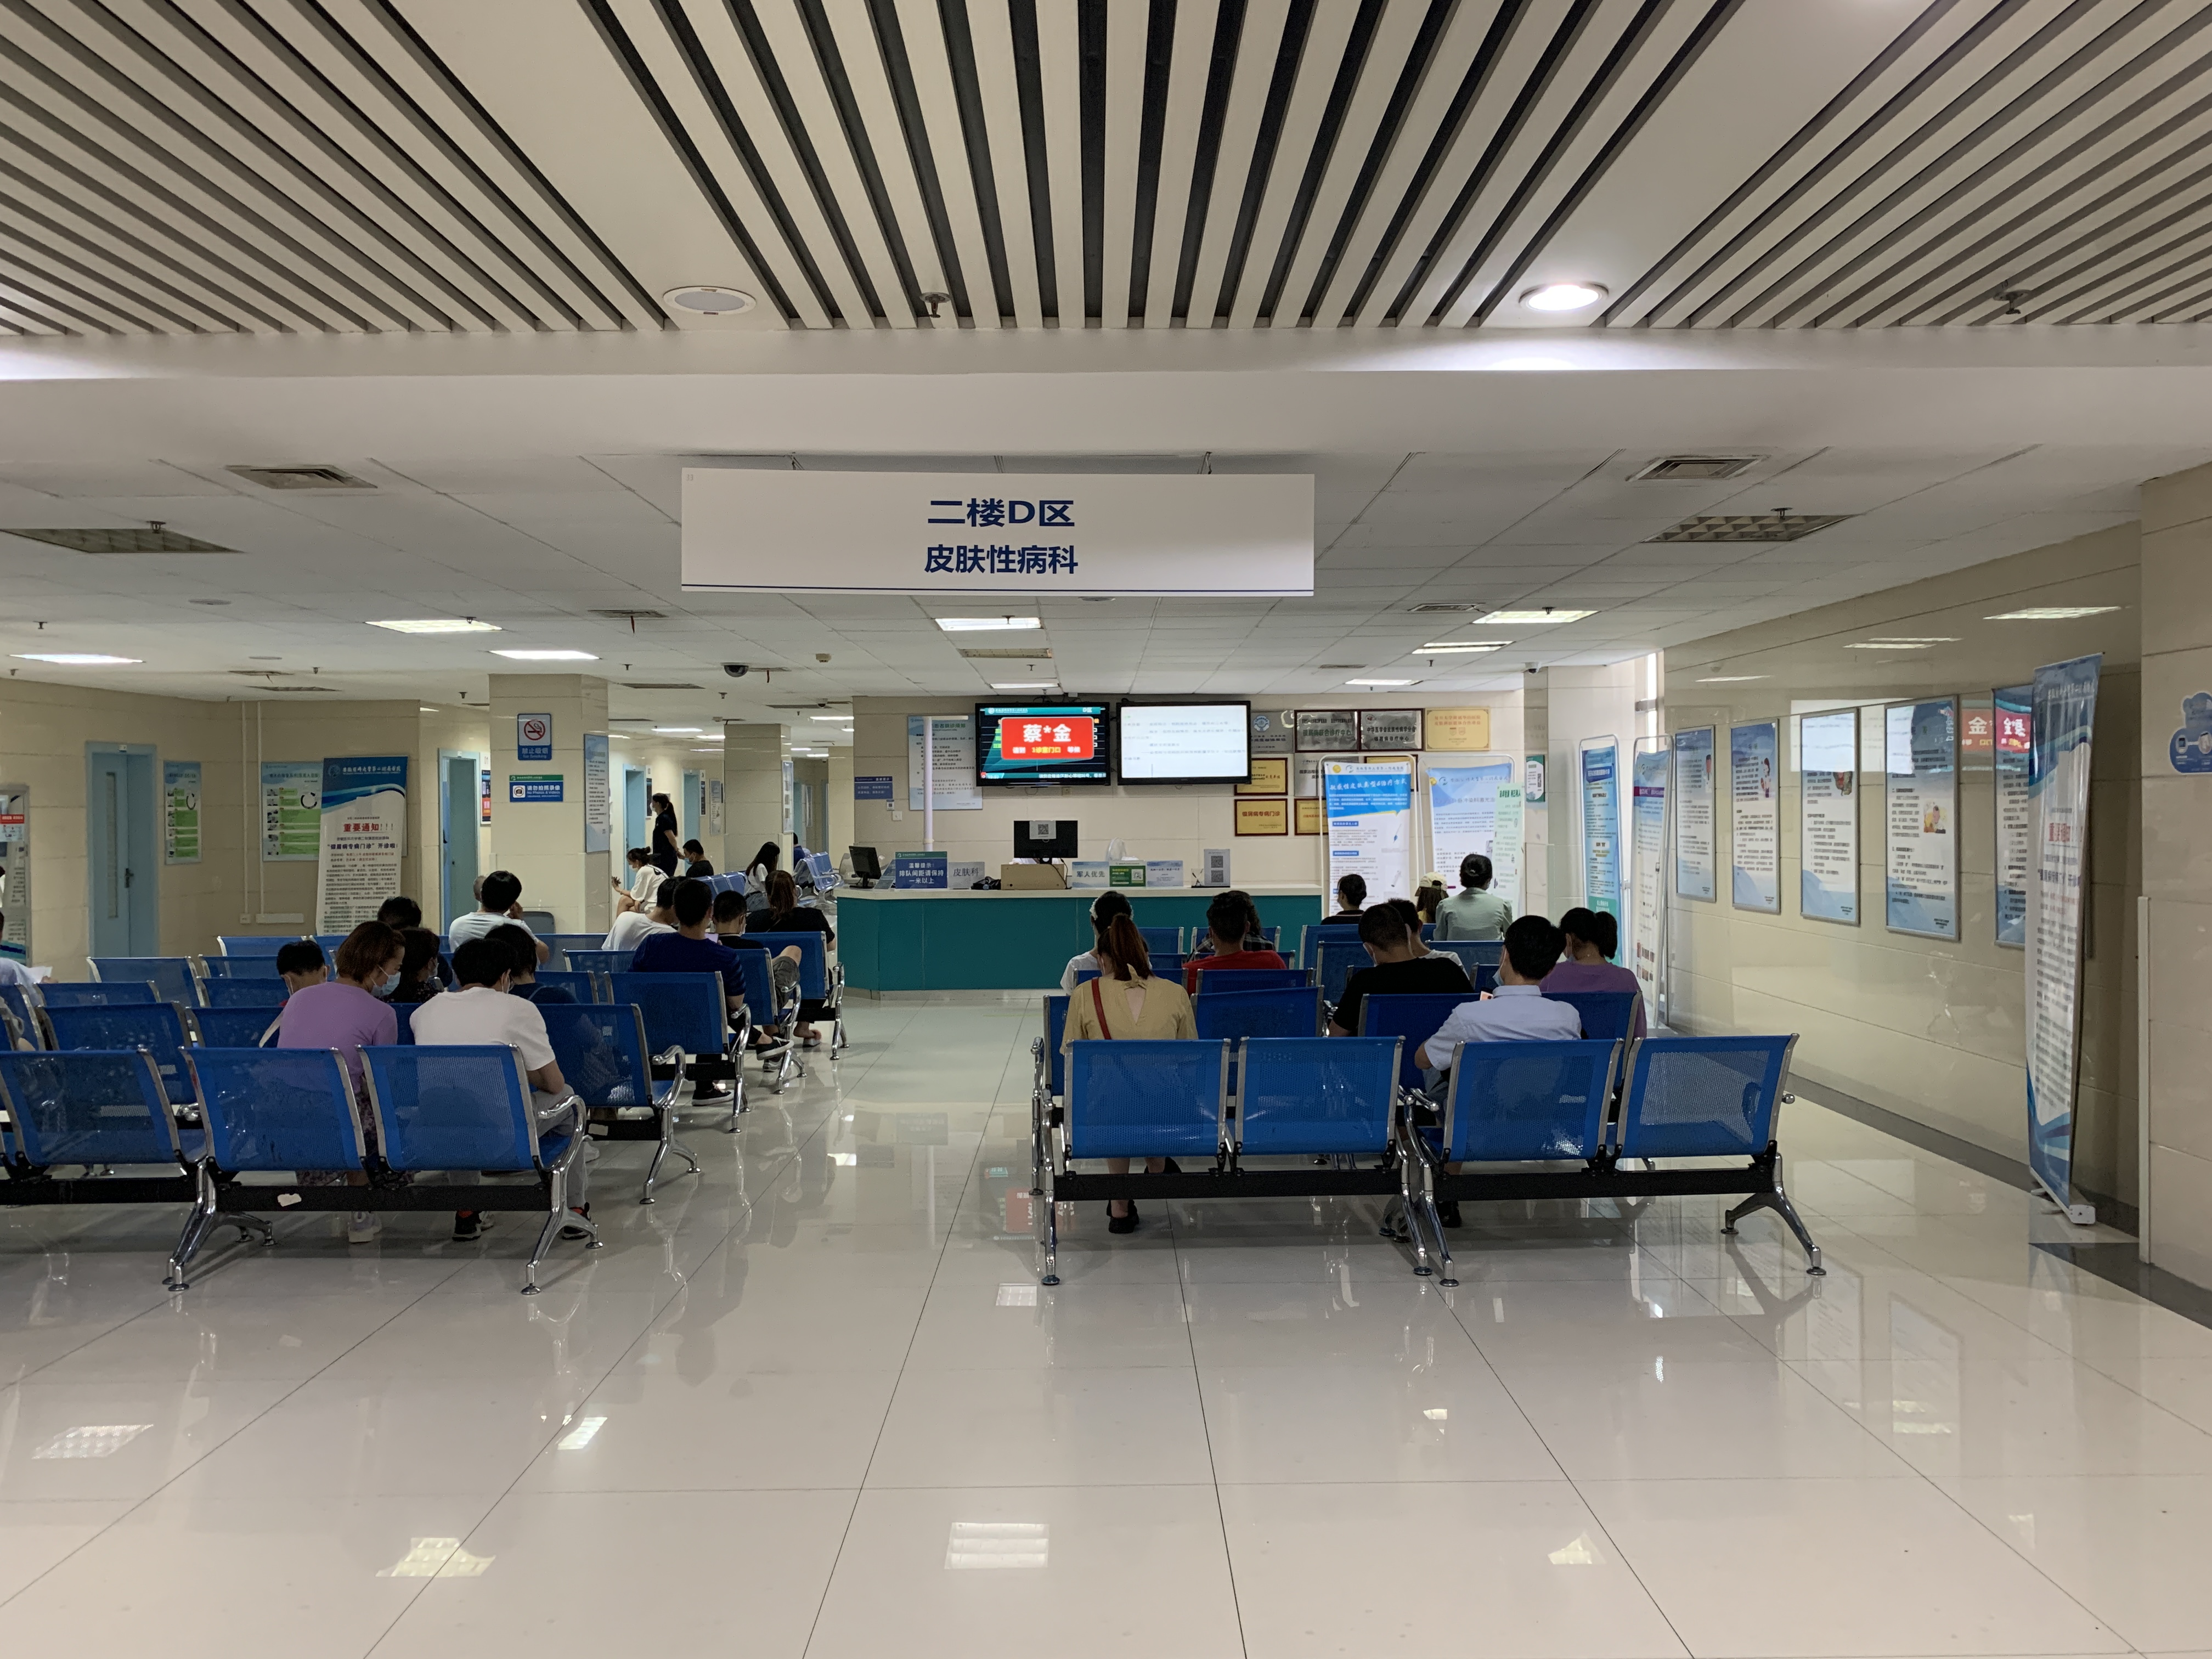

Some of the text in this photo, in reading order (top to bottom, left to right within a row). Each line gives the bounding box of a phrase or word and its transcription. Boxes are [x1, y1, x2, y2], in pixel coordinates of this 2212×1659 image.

[927, 498, 1076, 527] 二楼D区
[924, 545, 1079, 574] 皮肤性病科
[953, 867, 979, 877] 皮肤科
